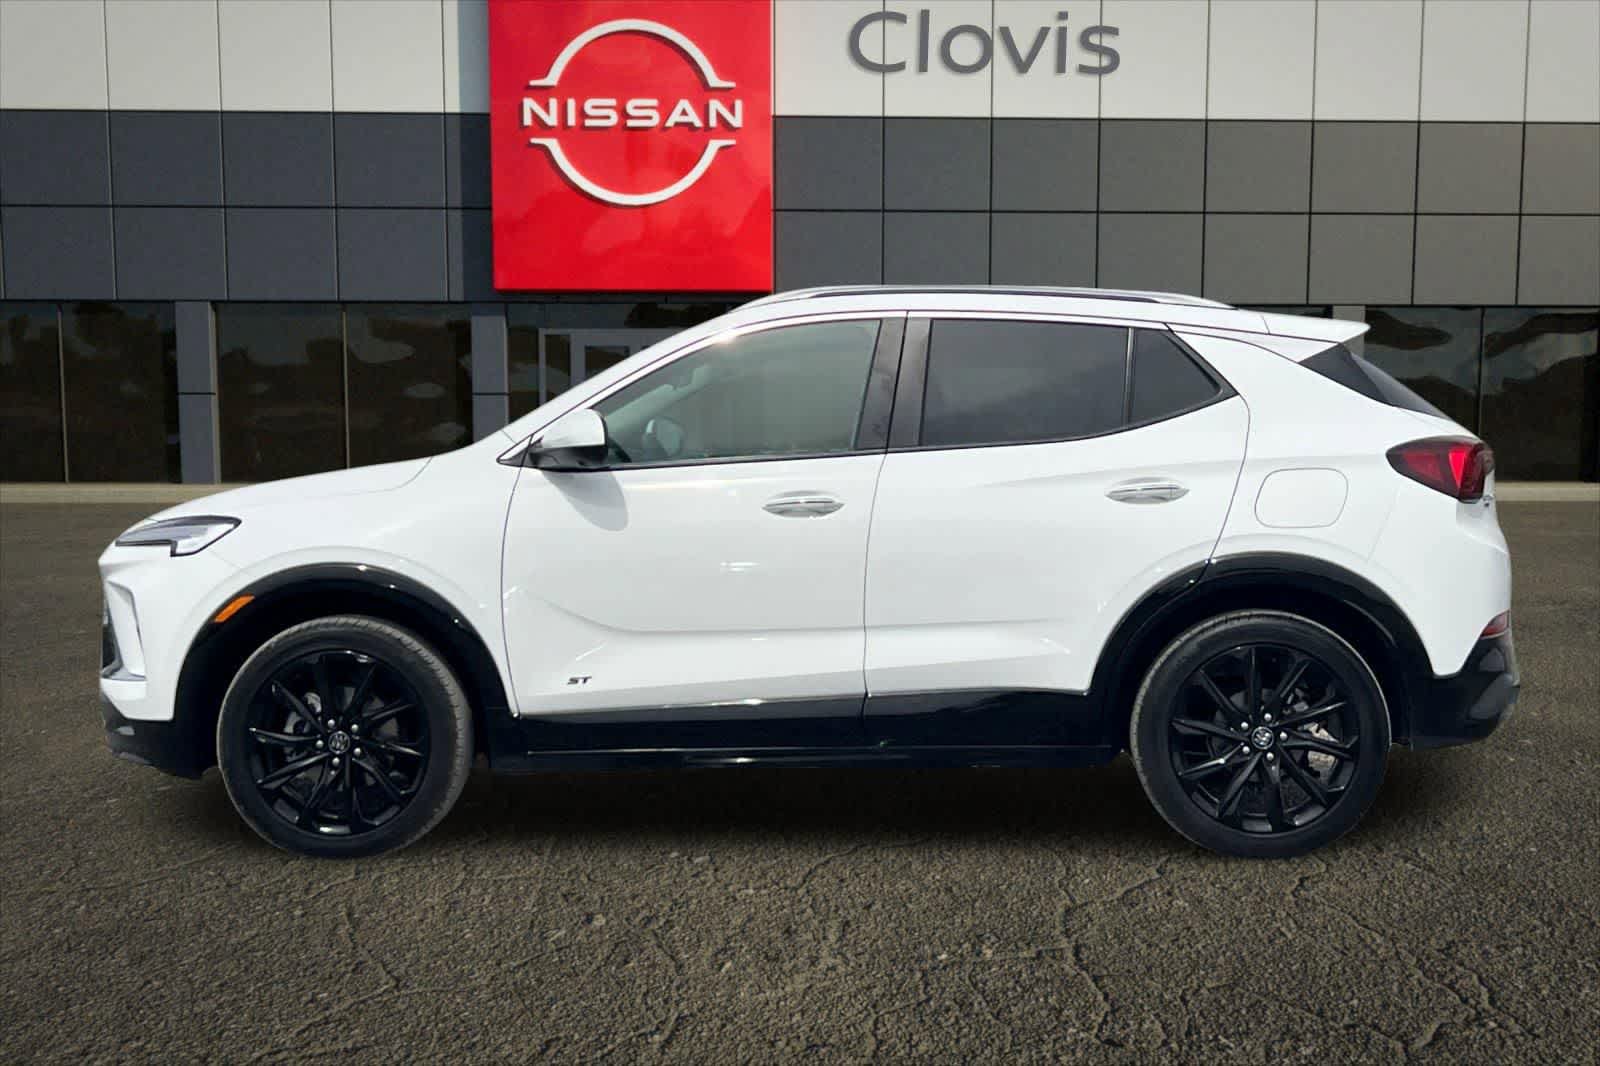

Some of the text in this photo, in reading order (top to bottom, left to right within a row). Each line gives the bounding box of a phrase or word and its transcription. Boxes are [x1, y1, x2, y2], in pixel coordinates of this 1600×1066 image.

[848, 9, 1121, 76] Clovis
[522, 97, 743, 129] NISSAN
[567, 675, 593, 685] ST
